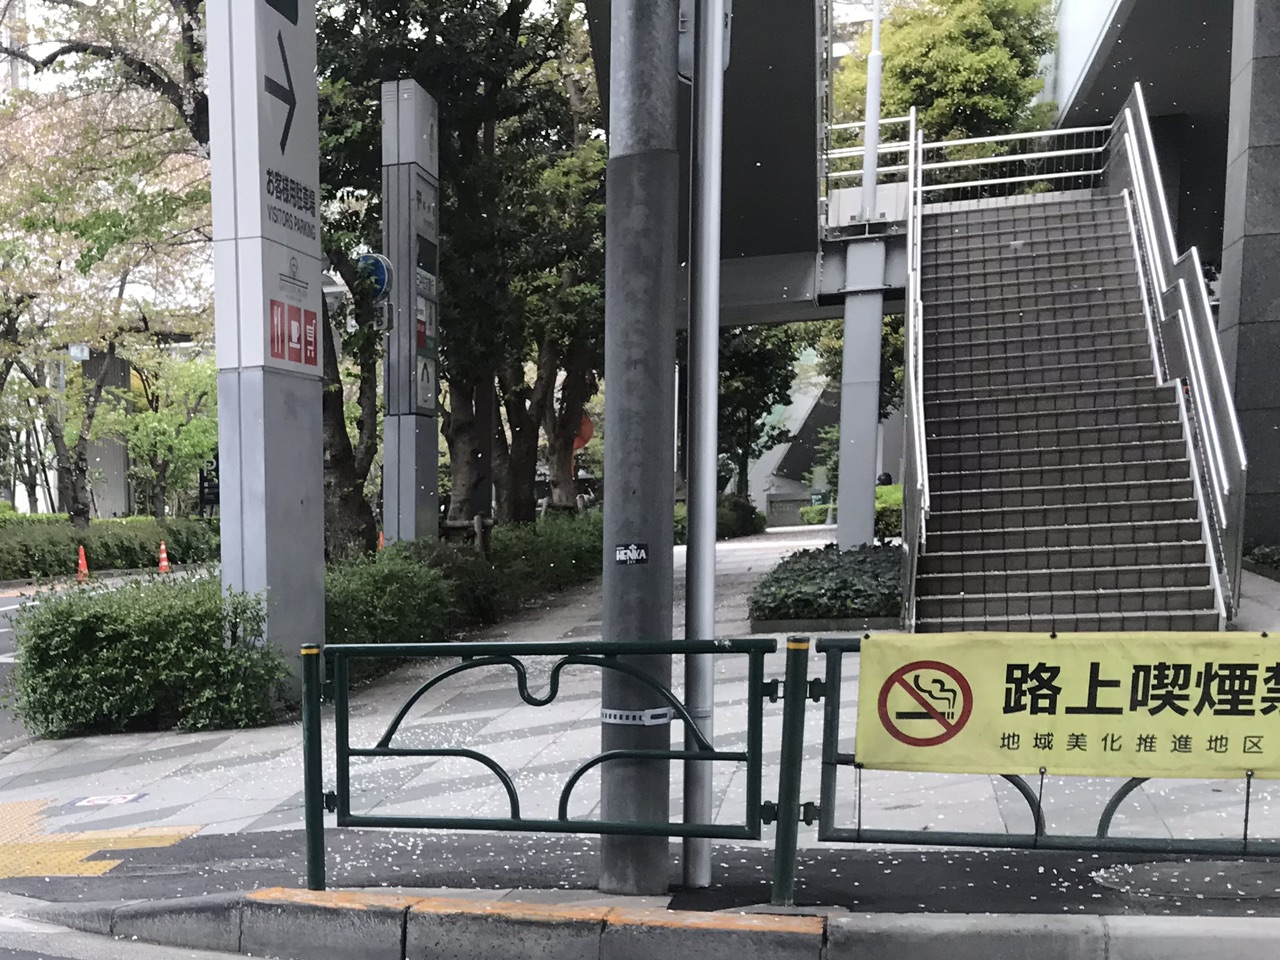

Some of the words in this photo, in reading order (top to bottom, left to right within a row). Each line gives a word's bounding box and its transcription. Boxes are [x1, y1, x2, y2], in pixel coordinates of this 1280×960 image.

[266, 168, 316, 218] お客様用駐車場
[267, 203, 293, 231] VISITORS
[294, 215, 316, 240] PARKING
[616, 549, 647, 561] HENKA
[1000, 732, 1265, 754] 地域美化推進地区
